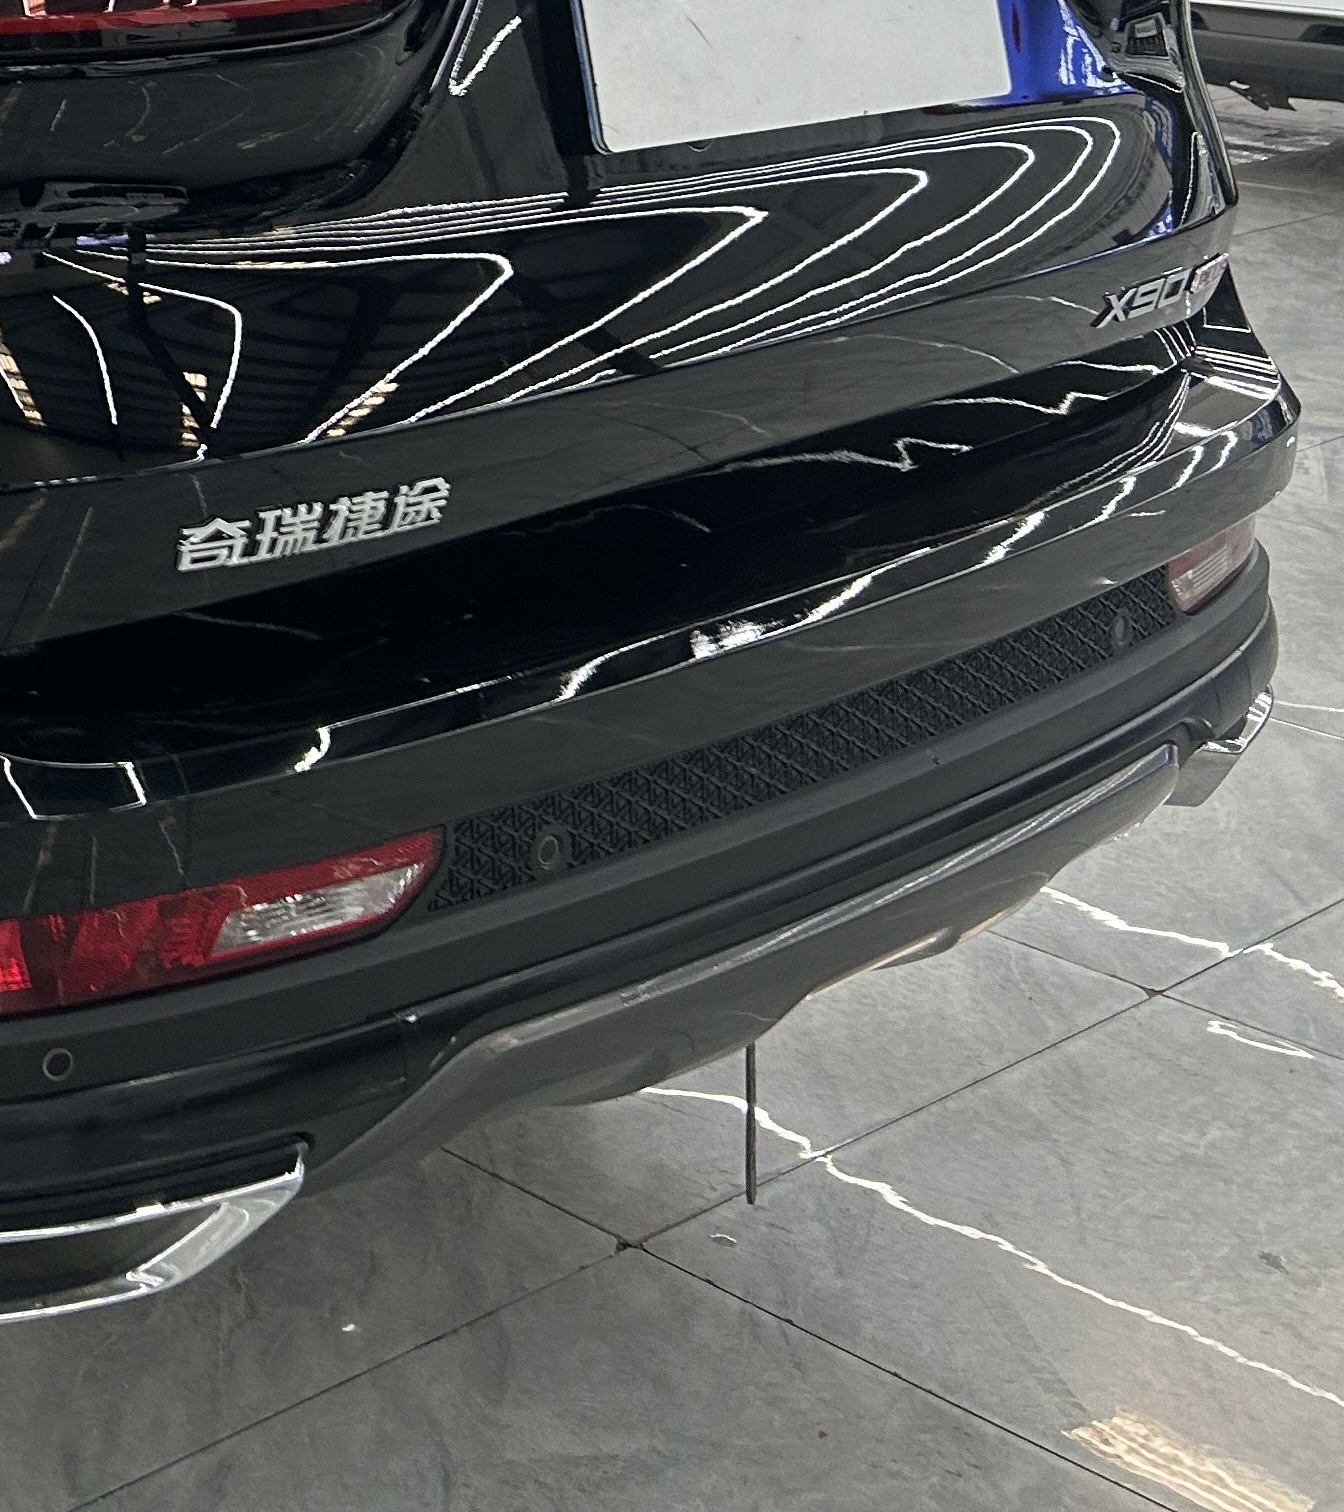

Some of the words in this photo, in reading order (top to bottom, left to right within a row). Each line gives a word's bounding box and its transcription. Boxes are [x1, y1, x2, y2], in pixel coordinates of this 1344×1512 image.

[1092, 268, 1192, 328] X90
[176, 477, 452, 572] 奇瑞捷途
